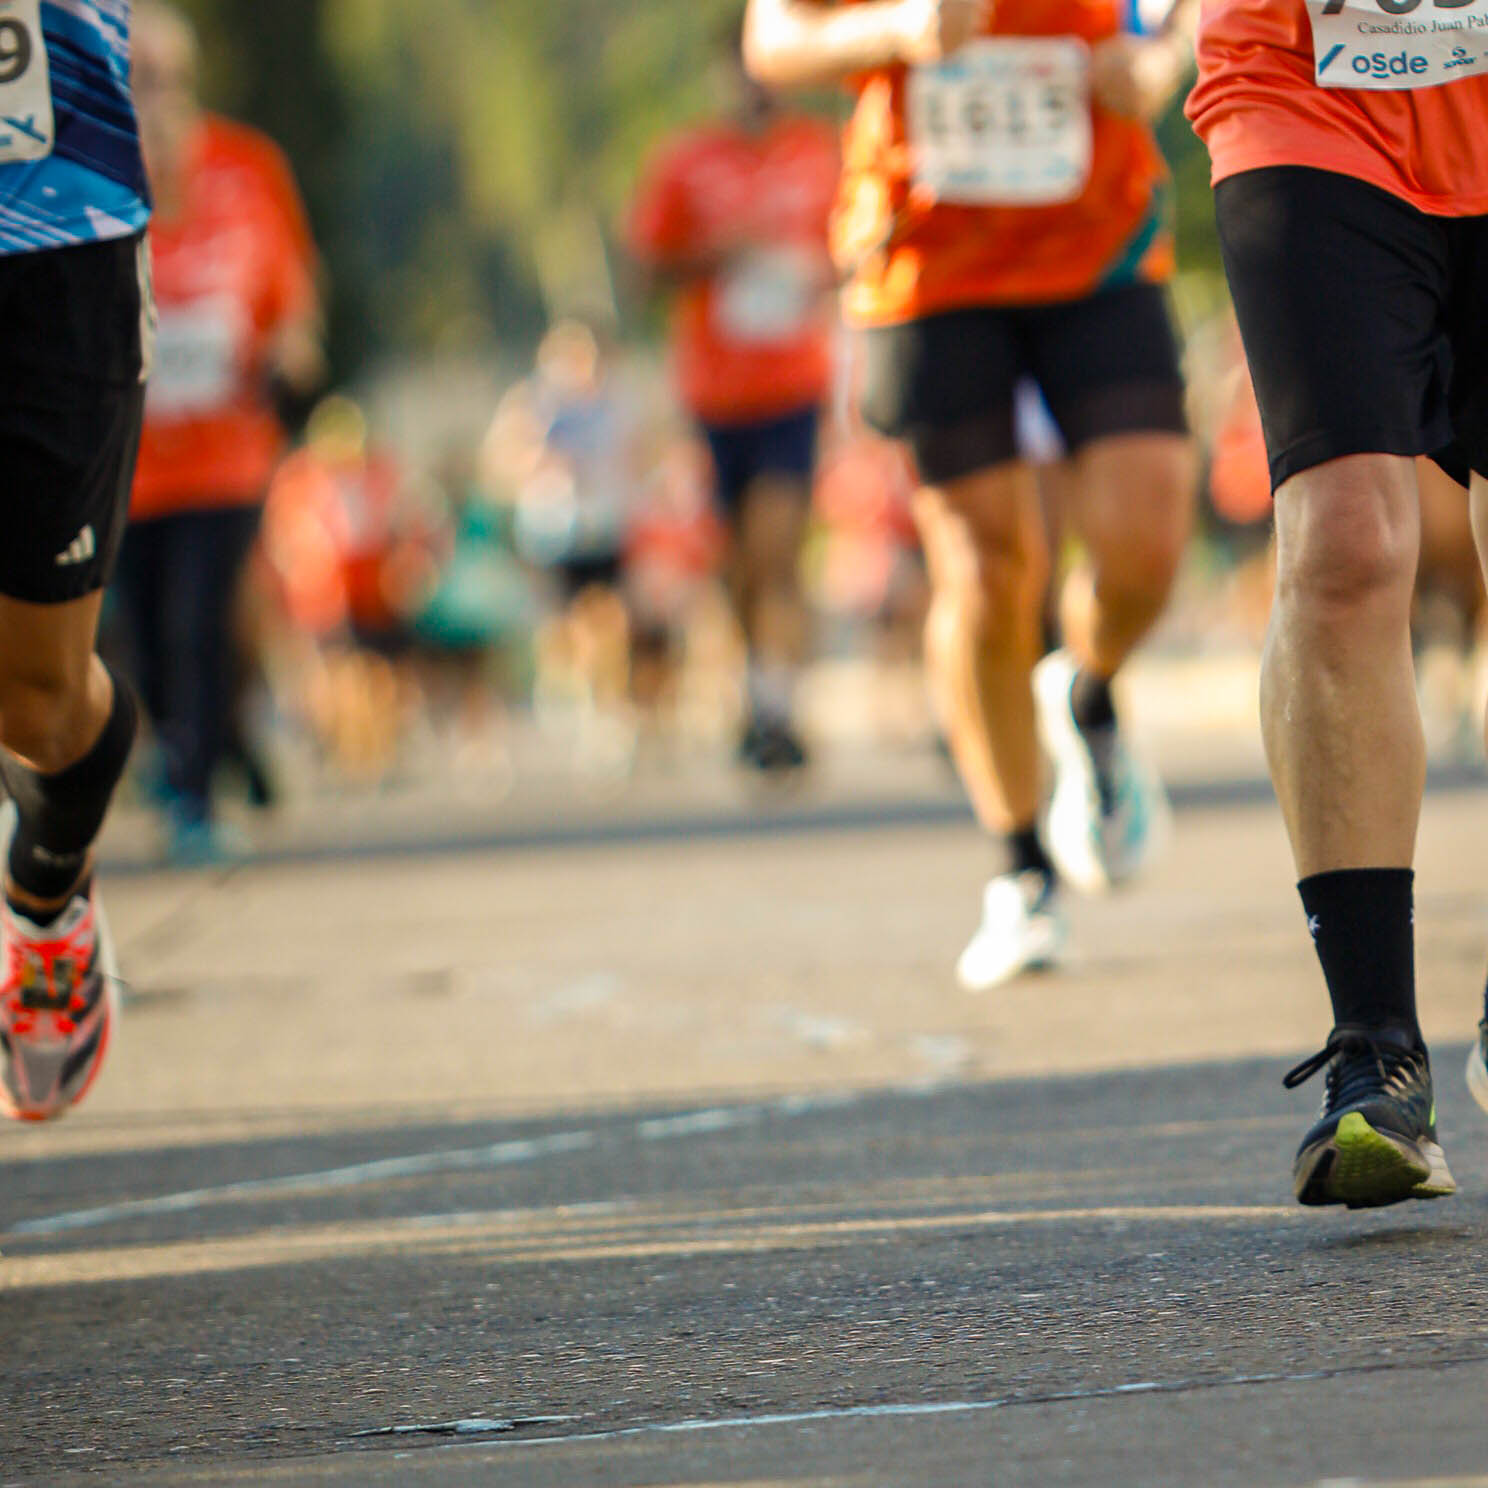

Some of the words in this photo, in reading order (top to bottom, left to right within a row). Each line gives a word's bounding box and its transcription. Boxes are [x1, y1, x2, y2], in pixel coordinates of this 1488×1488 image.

[1357, 21, 1427, 35] Casadidio
[1431, 19, 1463, 33] Juan
[1351, 50, 1429, 78] osde
